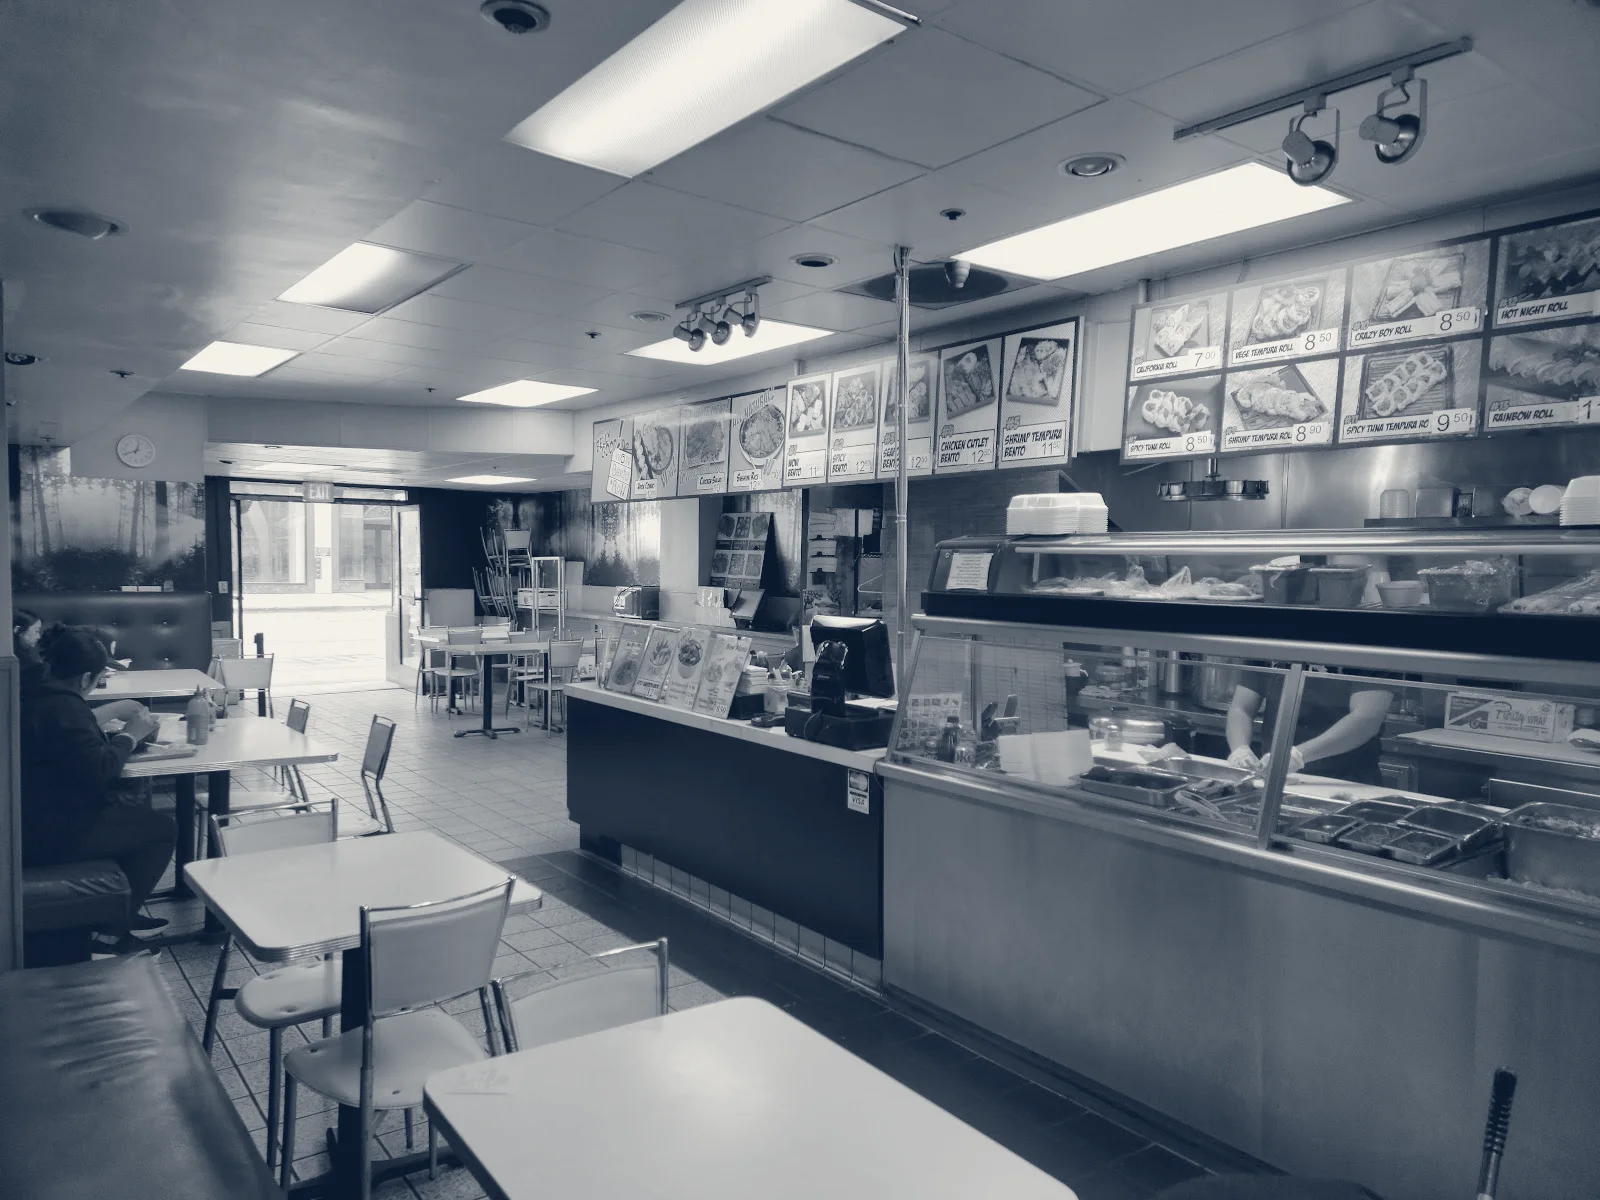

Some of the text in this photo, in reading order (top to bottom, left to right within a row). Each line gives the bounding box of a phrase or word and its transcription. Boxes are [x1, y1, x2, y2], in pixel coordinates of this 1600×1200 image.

[1501, 301, 1568, 319] HOT NIGHT ROLL
[1440, 313, 1452, 331] 8
[1355, 325, 1412, 341] CRAZY BOY ROLL
[1304, 334, 1316, 350] 8
[1235, 343, 1294, 358] VEGE TEMPURA ROLL
[1136, 361, 1178, 374] CALIFORNIA ROLL
[1492, 409, 1554, 422] RAINBOW ROLL
[1346, 419, 1430, 435] SPICY TUNA TEMPURA RO
[1437, 414, 1450, 432] 9
[1004, 428, 1063, 445] SHRIMP TEMPURA
[1228, 434, 1251, 444] SHRIMP
[1252, 432, 1278, 442] TEMPURA
[1296, 426, 1306, 442] 8
[941, 437, 989, 451] CHICKEN CUTLET
[1130, 442, 1171, 453] SPICY TUNA ROLL
[832, 453, 846, 463] SPICY
[940, 452, 960, 463] BENTO
[1004, 446, 1026, 457] BENTO
[787, 467, 801, 477] BENTO
[831, 463, 848, 473] BENTO
[309, 483, 330, 500] EXIT
[852, 796, 865, 805] VISA
